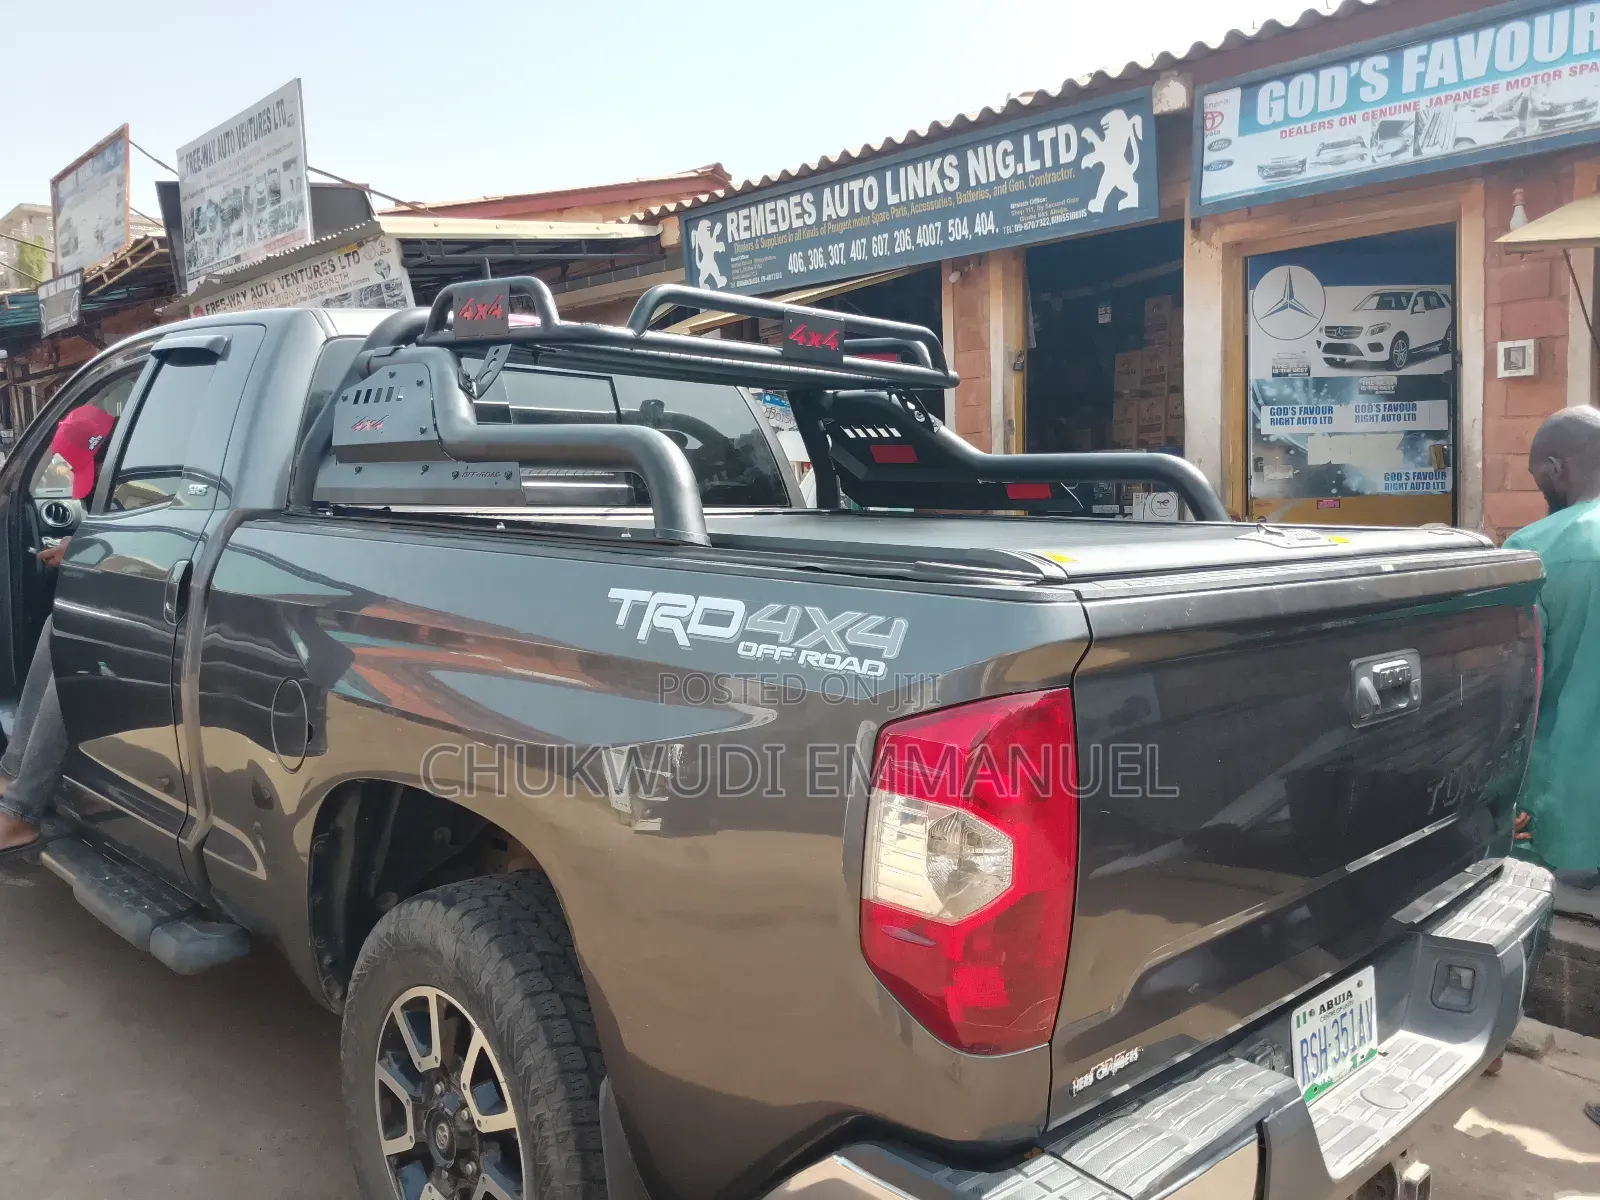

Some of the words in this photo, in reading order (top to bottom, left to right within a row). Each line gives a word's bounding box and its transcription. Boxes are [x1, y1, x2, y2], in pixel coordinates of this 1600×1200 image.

[1257, 55, 1389, 126] GOD'S
[1402, 3, 1600, 94] FAVOUR
[1279, 118, 1335, 140] DEALERS
[1338, 114, 1357, 127] ON
[1361, 100, 1421, 122] GENUINE
[1425, 82, 1500, 108] JAPANESE
[1505, 70, 1563, 92] MOTOR
[217, 129, 236, 161] AUTO
[236, 106, 272, 151] VENTURES
[272, 97, 287, 130] LTD
[726, 192, 817, 243] REMEDES
[822, 175, 879, 222] AUTO
[886, 154, 960, 205] LINKS
[788, 231, 794, 243] in
[802, 226, 819, 239] Kinds
[820, 224, 827, 235] of
[852, 215, 871, 228] motor
[871, 211, 890, 226] Spare
[993, 183, 1007, 197] and
[1008, 179, 1027, 193] Gen.
[250, 280, 276, 300] AUTO
[277, 258, 336, 290] VENTURES
[337, 249, 361, 270] LTD
[1270, 406, 1297, 417] GOD'S
[1299, 405, 1333, 416] FAVOUR
[1270, 417, 1294, 426] RIGHT
[1296, 416, 1318, 426] AUTO
[1319, 416, 1333, 425] LTD
[1354, 403, 1381, 414] GOD'S
[1383, 402, 1417, 413] FAVOUR
[1355, 414, 1379, 423] RIGHT
[1381, 413, 1402, 423] AUTO
[1403, 413, 1417, 422] LTD
[1384, 471, 1411, 482] GOD'S
[1412, 471, 1447, 482] FAVOUR
[1384, 481, 1408, 491] RIGHT
[1410, 481, 1431, 490] AUTO
[1432, 481, 1446, 490] LTD
[607, 588, 747, 650] TRD
[737, 641, 796, 664] OFF
[798, 649, 888, 681] ROAD
